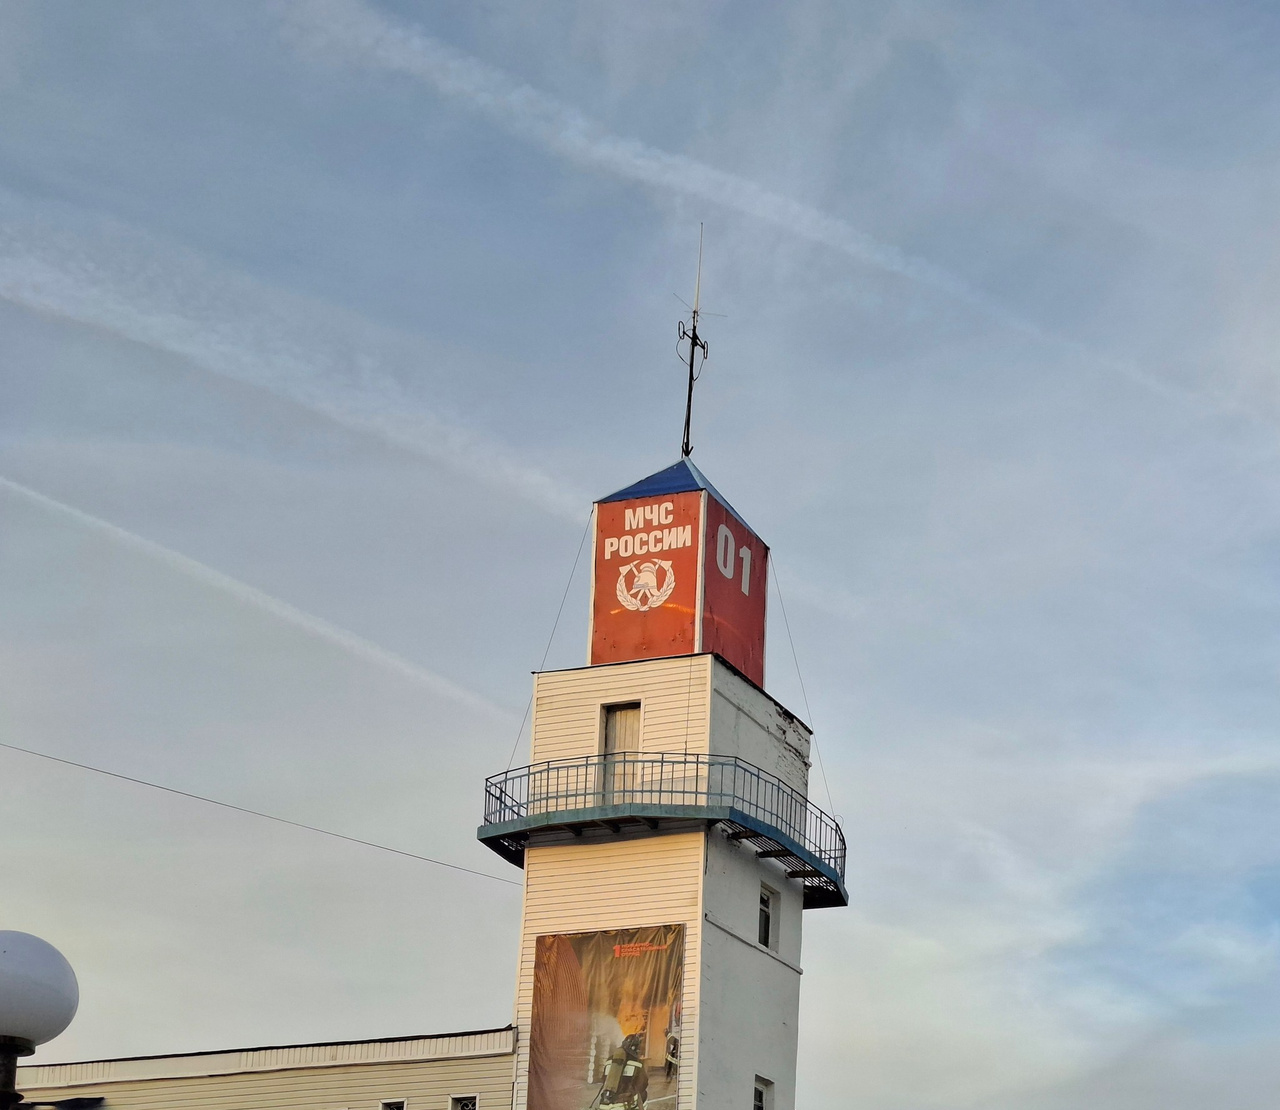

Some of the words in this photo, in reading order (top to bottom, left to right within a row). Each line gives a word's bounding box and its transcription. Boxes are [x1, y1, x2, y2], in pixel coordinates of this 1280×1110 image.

[624, 501, 674, 531] МЧС
[604, 524, 692, 560] РОССИИ
[716, 523, 751, 597] 01
[613, 945, 620, 957] 1
